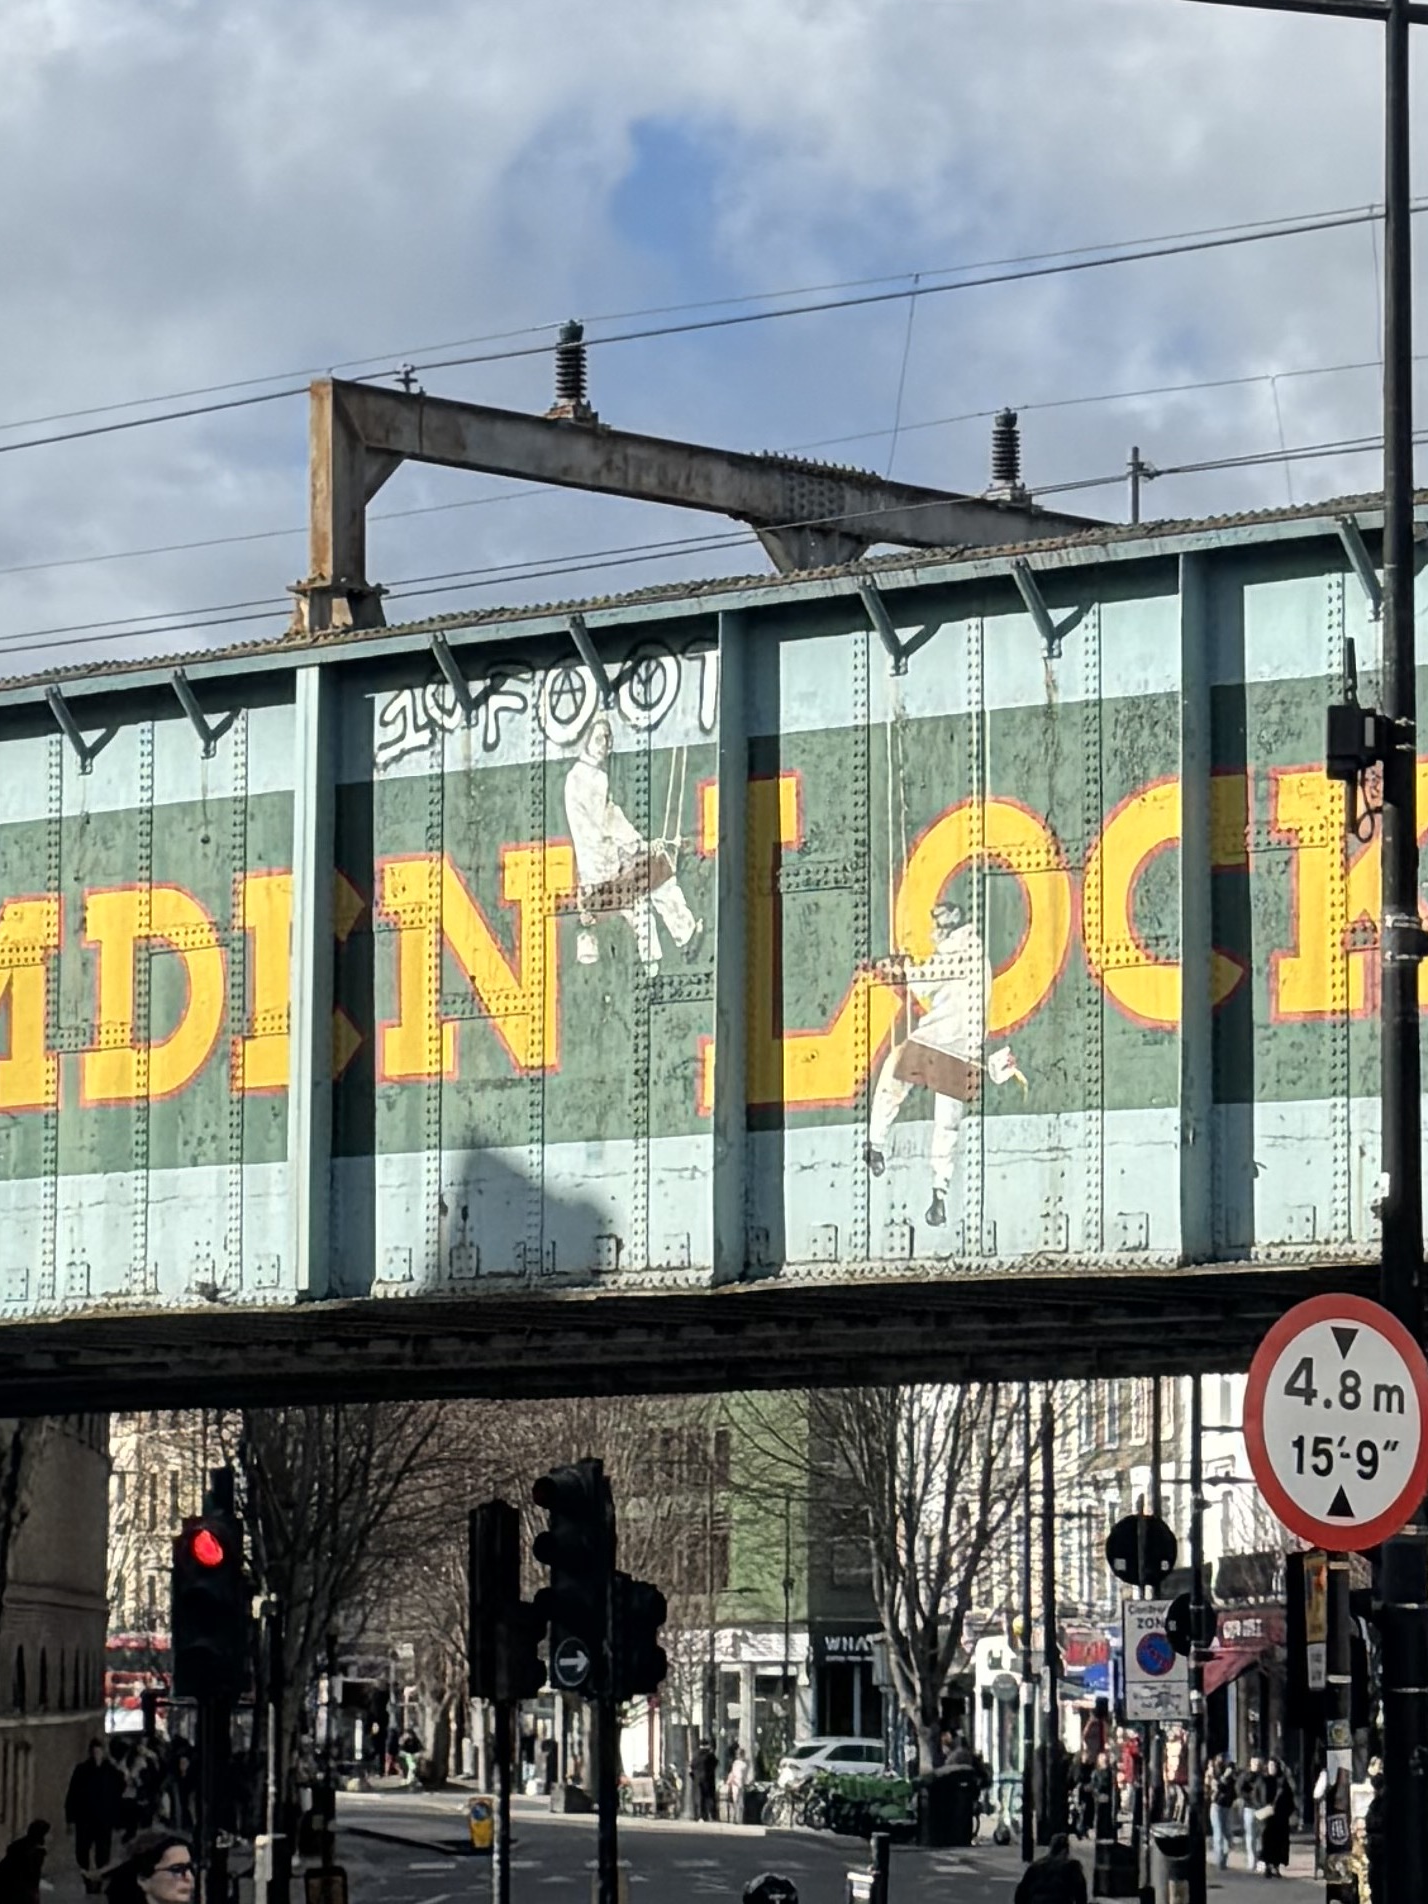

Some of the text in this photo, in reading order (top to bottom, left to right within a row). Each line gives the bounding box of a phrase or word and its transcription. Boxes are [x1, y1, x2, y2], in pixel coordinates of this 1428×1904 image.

[1284, 1357, 1405, 1415] 4.8 m
[1136, 1616, 1167, 1630] ZON
